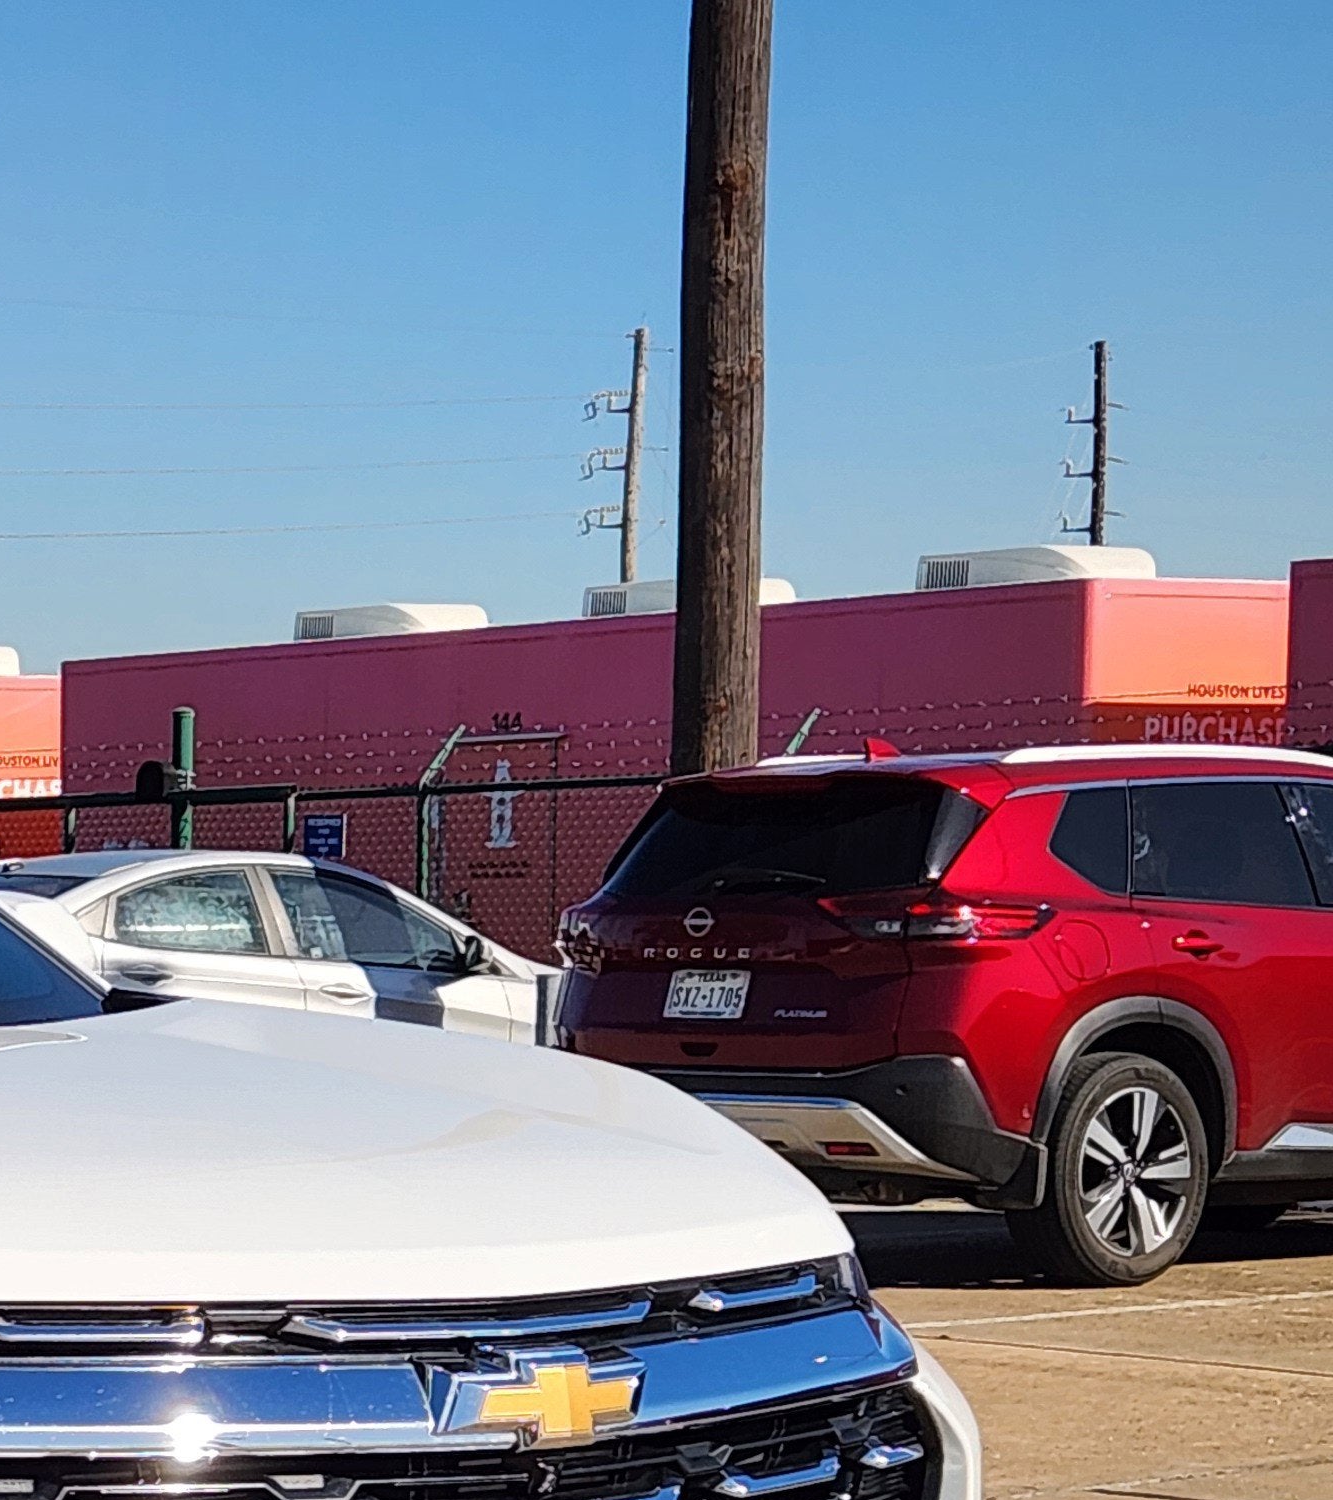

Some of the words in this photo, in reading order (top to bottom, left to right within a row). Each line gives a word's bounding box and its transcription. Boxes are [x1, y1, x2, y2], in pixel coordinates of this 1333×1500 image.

[1187, 683, 1249, 698] HOUSTON
[1252, 685, 1285, 699] LIVES
[492, 711, 522, 731] 144
[643, 947, 751, 959] ROGUE
